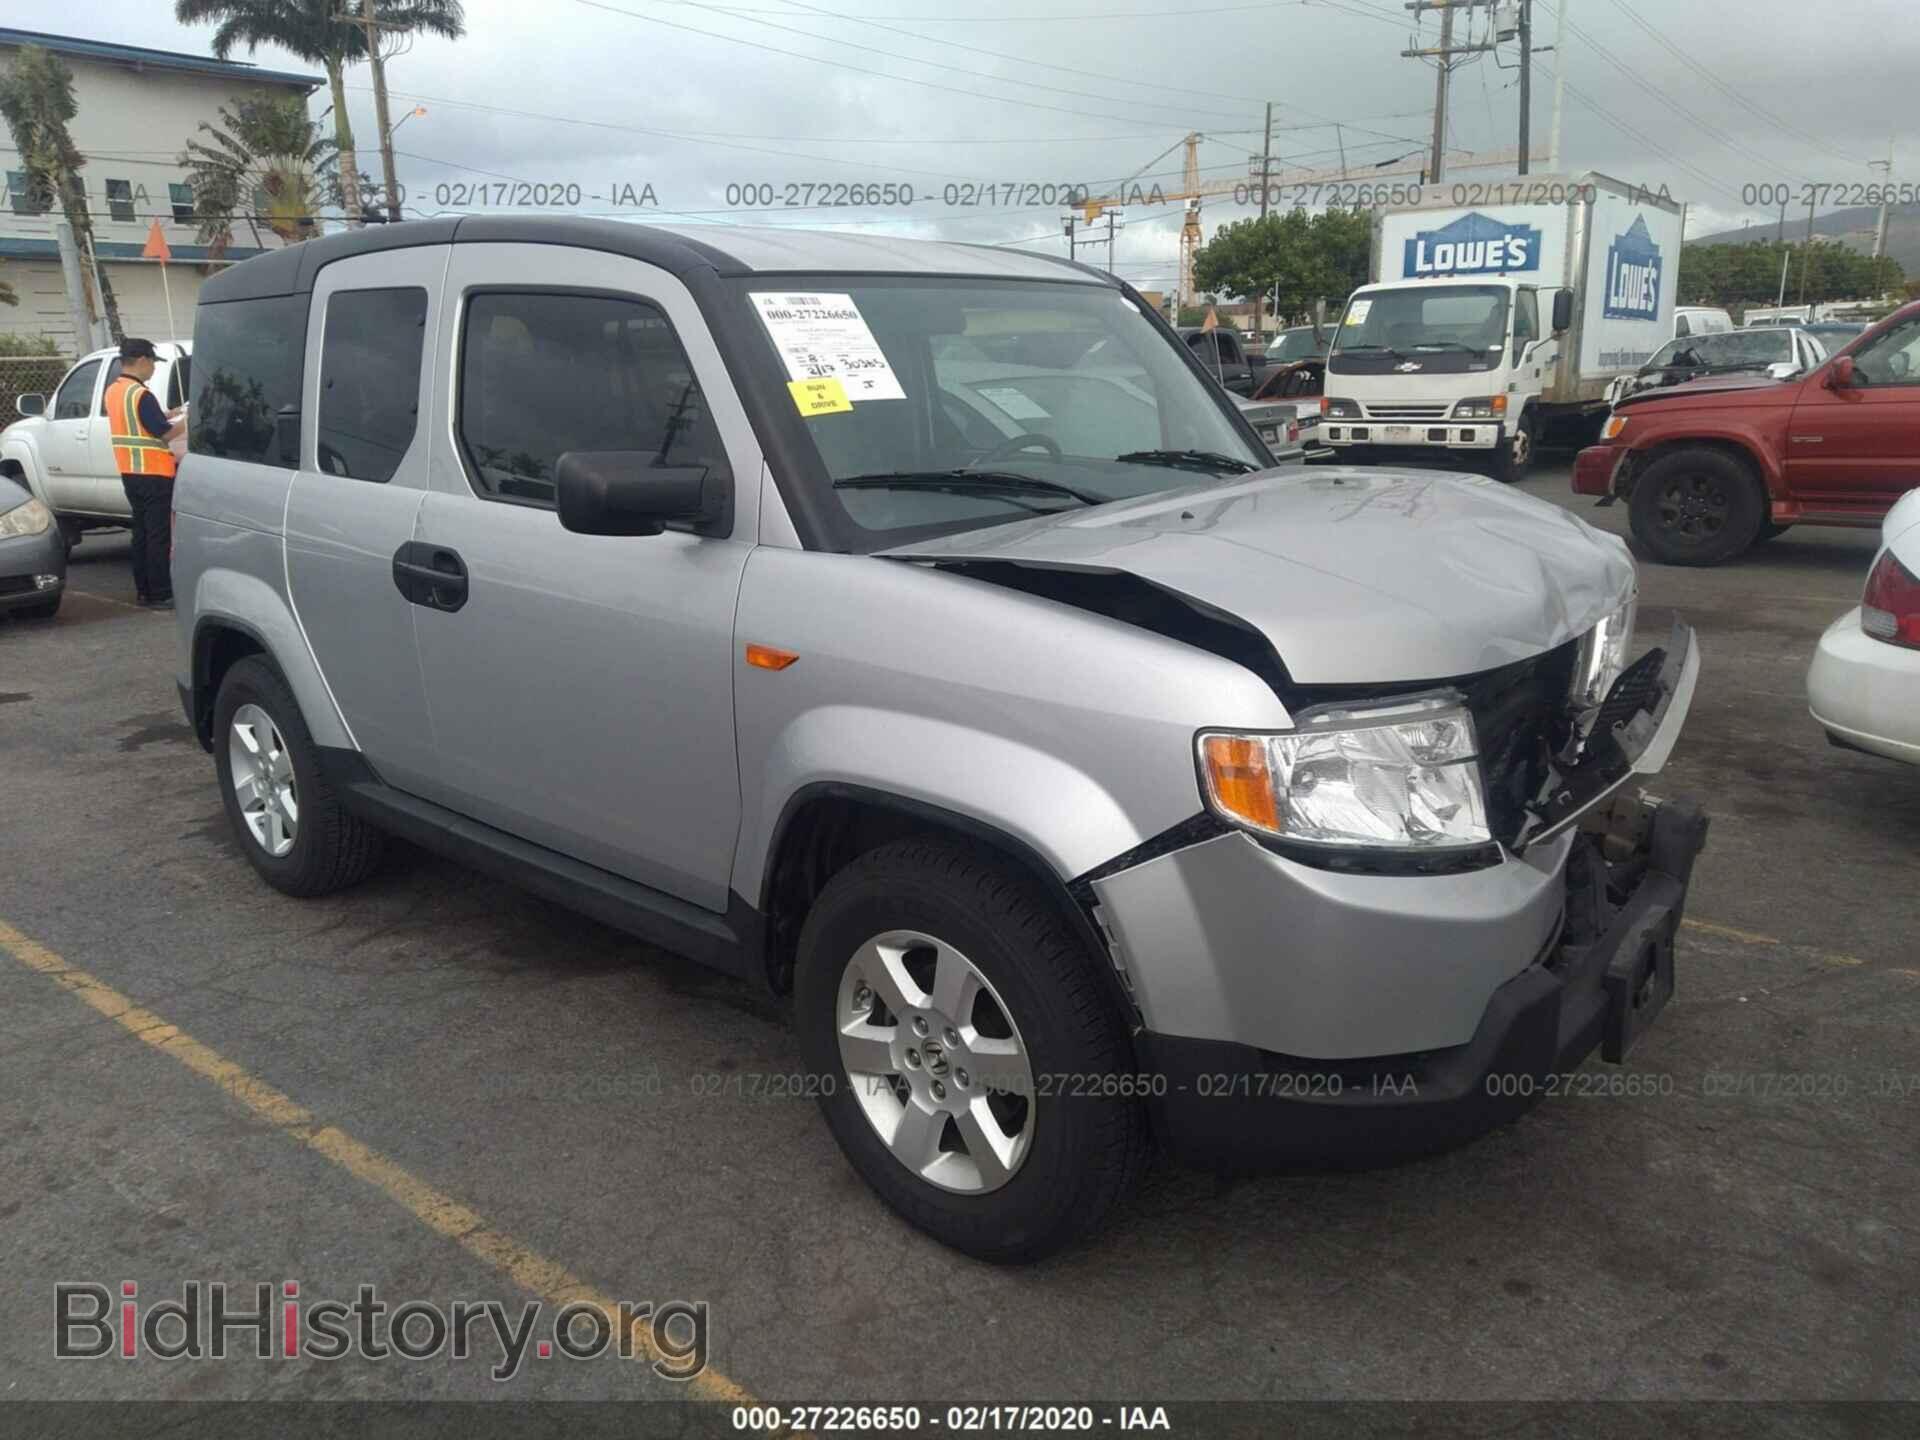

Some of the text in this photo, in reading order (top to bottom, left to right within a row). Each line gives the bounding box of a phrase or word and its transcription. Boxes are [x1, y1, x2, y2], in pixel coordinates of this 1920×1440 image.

[1416, 234, 1529, 272] LOWE'S
[1609, 251, 1658, 314] LOWE'S
[765, 309, 860, 320] 000-27226650
[806, 384, 827, 392] RUN
[810, 400, 839, 409] DRIVE
